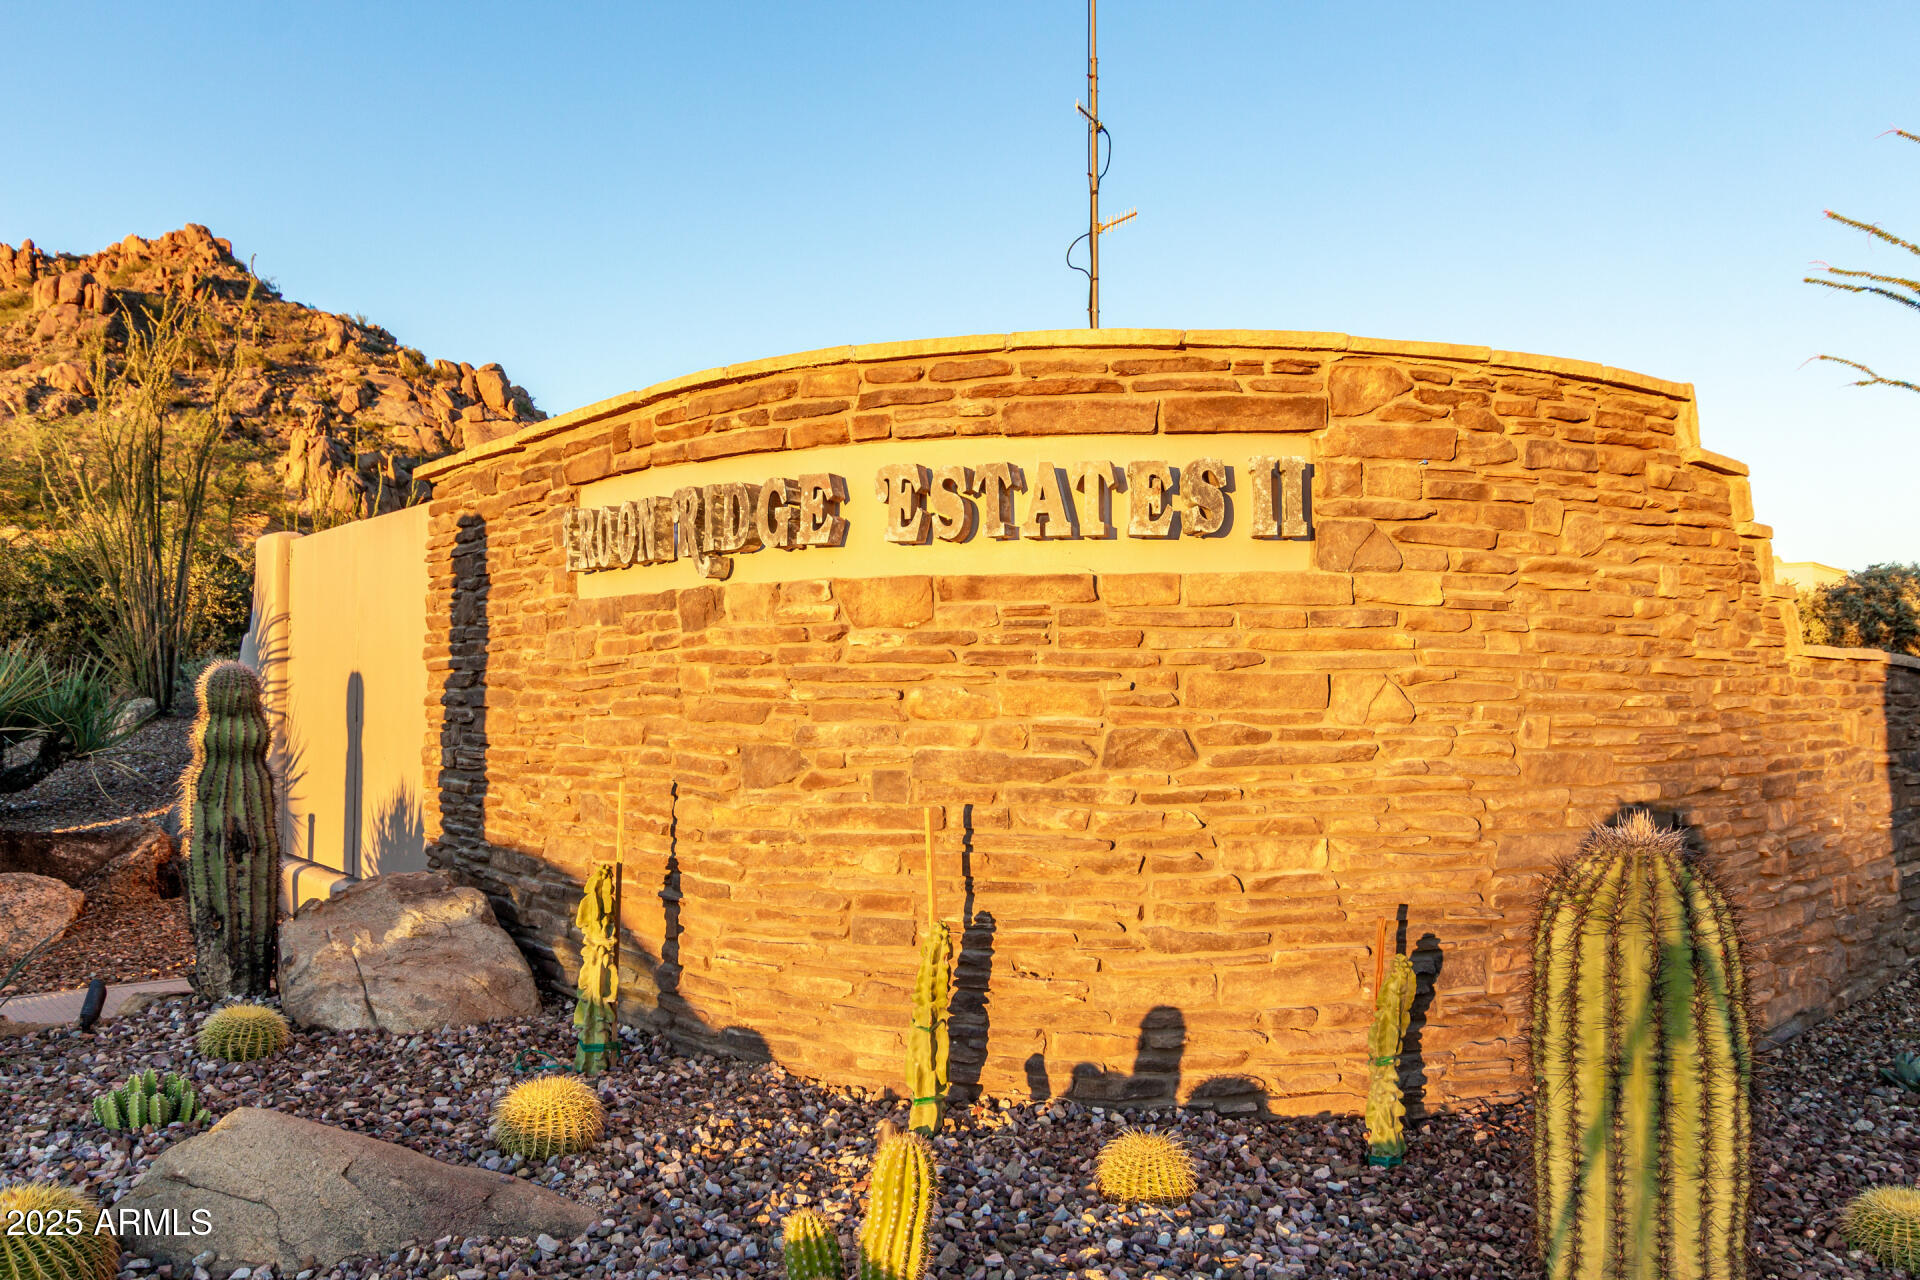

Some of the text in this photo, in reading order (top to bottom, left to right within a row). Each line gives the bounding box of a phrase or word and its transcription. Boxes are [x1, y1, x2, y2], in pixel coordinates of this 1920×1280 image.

[671, 473, 846, 580] RIDGE
[874, 460, 1226, 544] ESTATES
[1248, 455, 1312, 540] II
